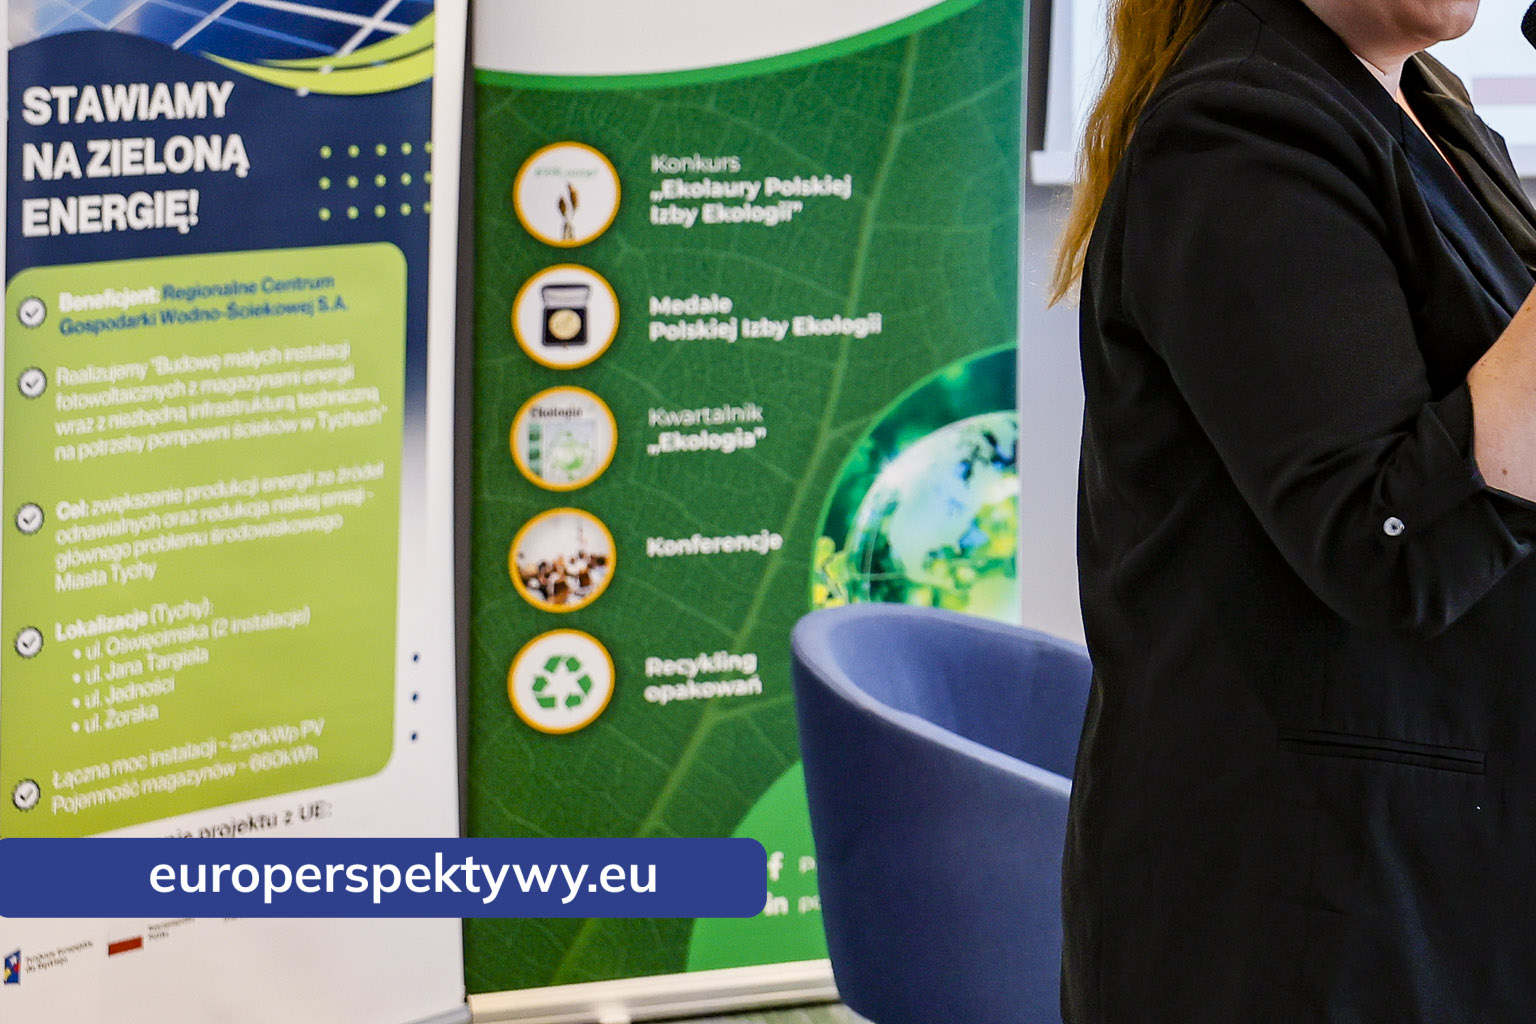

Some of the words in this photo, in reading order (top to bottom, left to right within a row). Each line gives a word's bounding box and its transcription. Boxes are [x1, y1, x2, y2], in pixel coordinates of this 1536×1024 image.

[22, 80, 235, 126] STAWIAMY
[22, 141, 83, 182] NA
[86, 133, 251, 179] ZIELONĄ
[650, 153, 741, 175] Konkurs
[764, 174, 852, 200] Polskiej
[22, 189, 200, 238] ENERGIĘ!
[650, 203, 698, 229] Izby
[59, 287, 161, 313] Beneficjent:
[162, 280, 258, 303] Regionalne
[261, 275, 336, 294] Centrum
[649, 293, 733, 317] Medale
[59, 314, 157, 338] Gospodarki
[160, 301, 315, 325] Wodno-Ściekowej
[649, 319, 738, 343] Polskiej
[742, 317, 790, 341] Izby
[792, 312, 882, 339] Ekologii
[648, 403, 763, 427] Kwartalnik
[56, 500, 91, 521] Cel:
[646, 529, 783, 558] Konferencje
[55, 567, 108, 593] Miasta
[111, 561, 157, 586] Tychy
[645, 651, 757, 679] Recykling
[644, 677, 762, 705] opakowań
